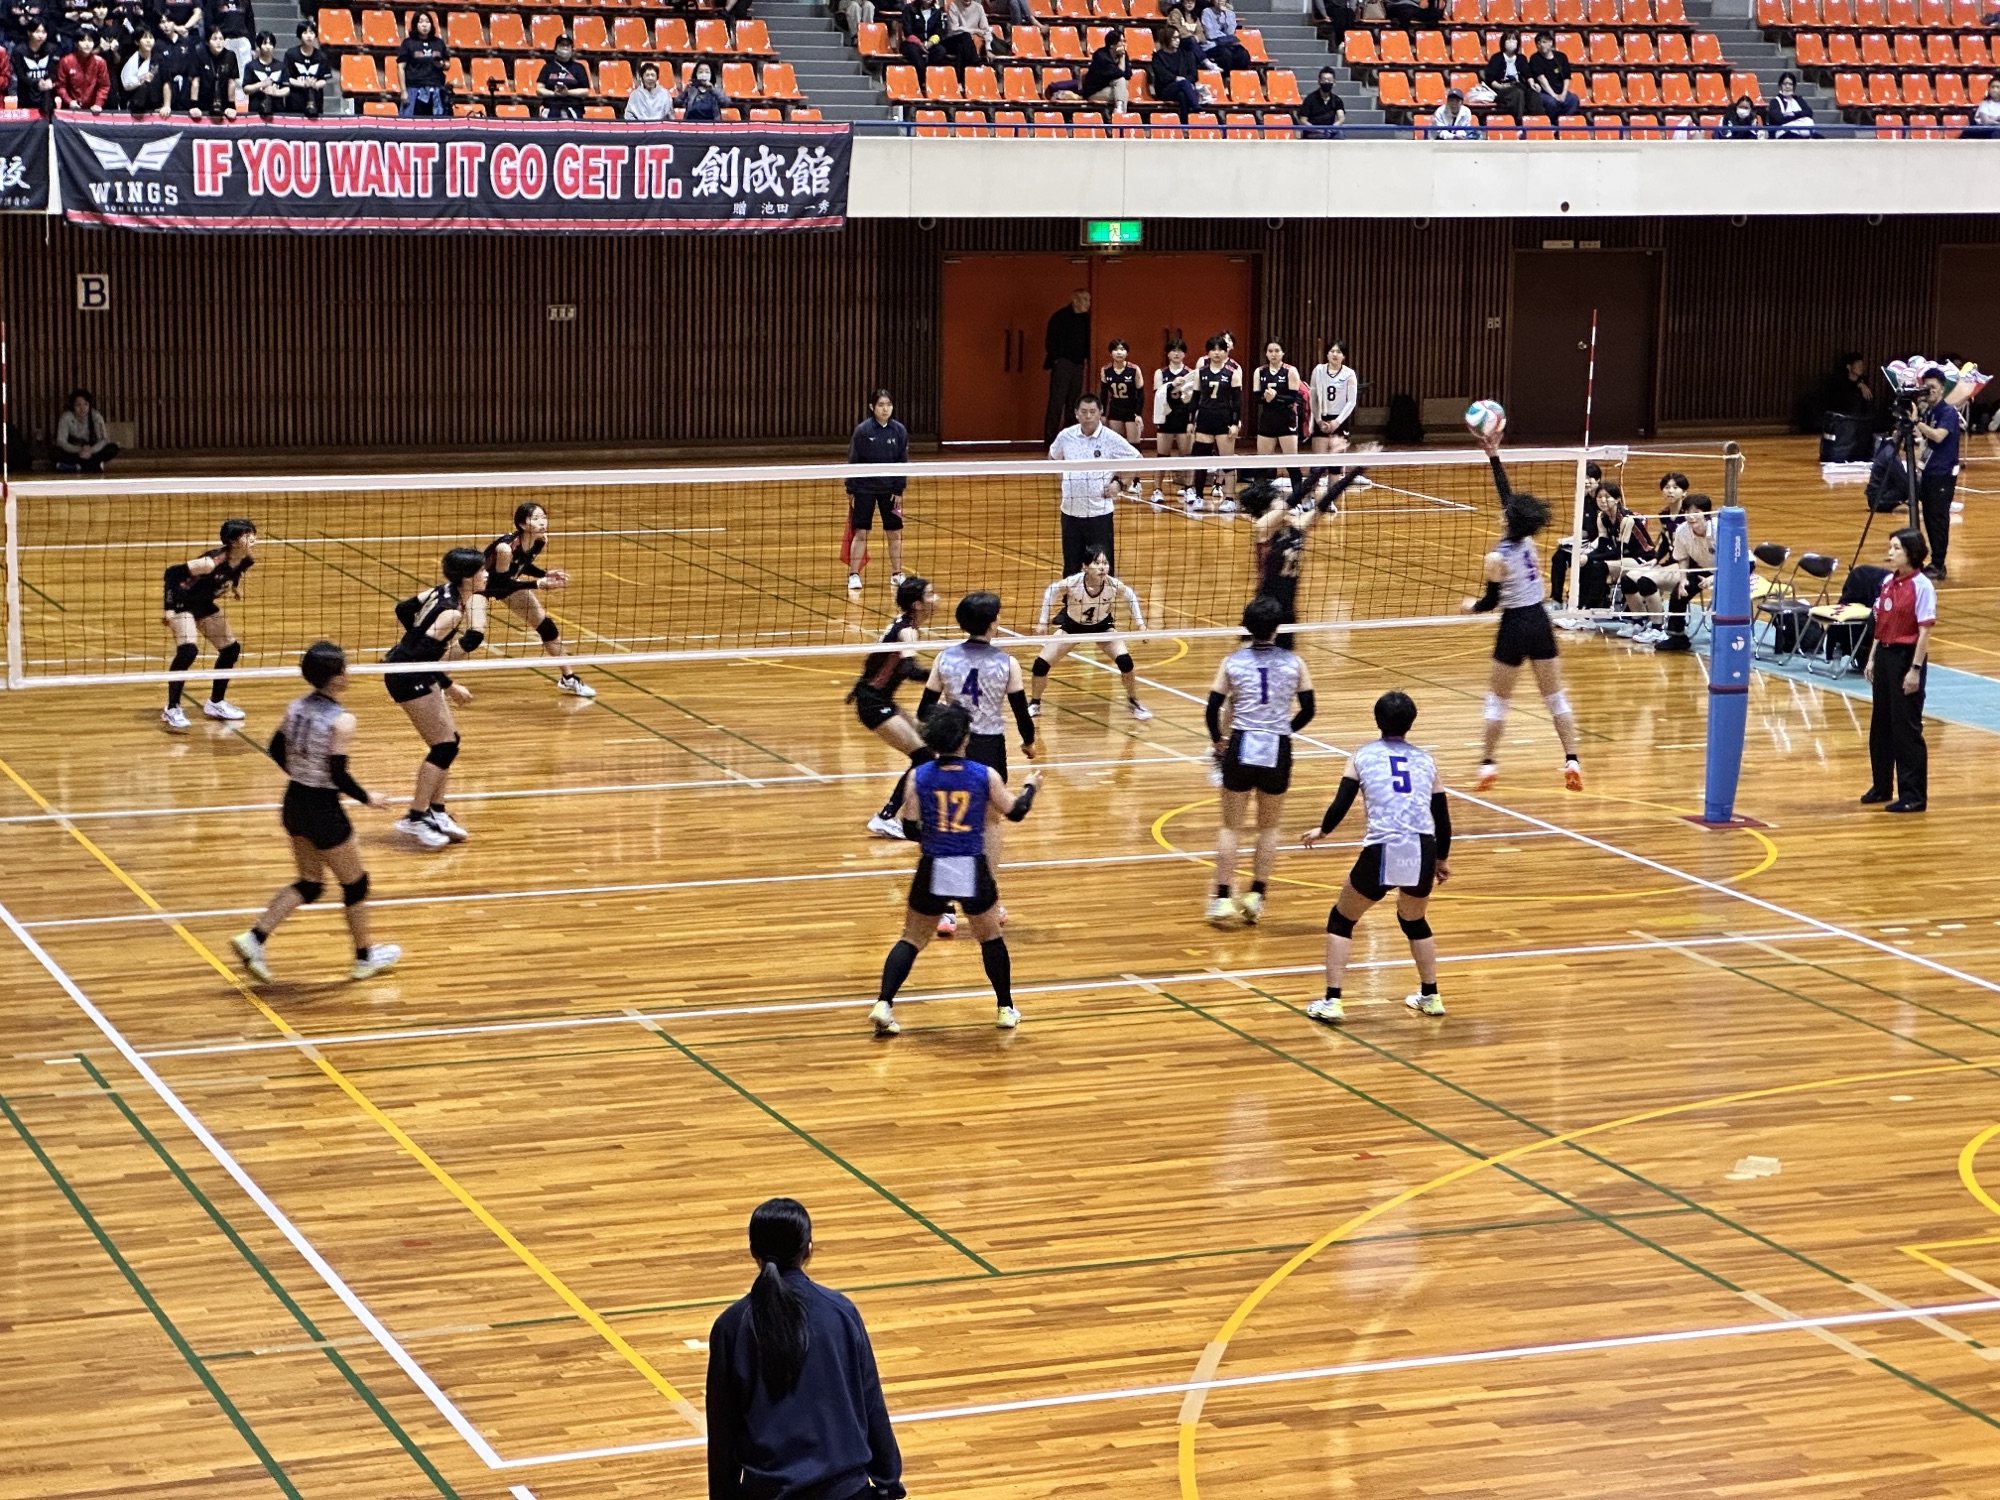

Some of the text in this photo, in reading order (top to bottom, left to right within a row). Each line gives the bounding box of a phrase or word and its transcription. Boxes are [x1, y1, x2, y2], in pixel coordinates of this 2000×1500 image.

[193, 139, 682, 199] IF YOU WANT IT GO GET IT.
[691, 144, 834, 198] 創成館
[89, 181, 178, 206] WINGS
[733, 200, 830, 215] 贈 池田 一秀
[82, 278, 106, 307] B
[1110, 382, 1129, 399] 12
[1208, 381, 1220, 399] 7
[1327, 386, 1337, 401] 8
[1082, 606, 1096, 621] 4
[961, 668, 983, 706] 4
[1256, 667, 1269, 705] 1
[1389, 755, 1412, 794] 5
[933, 790, 973, 833] 12
